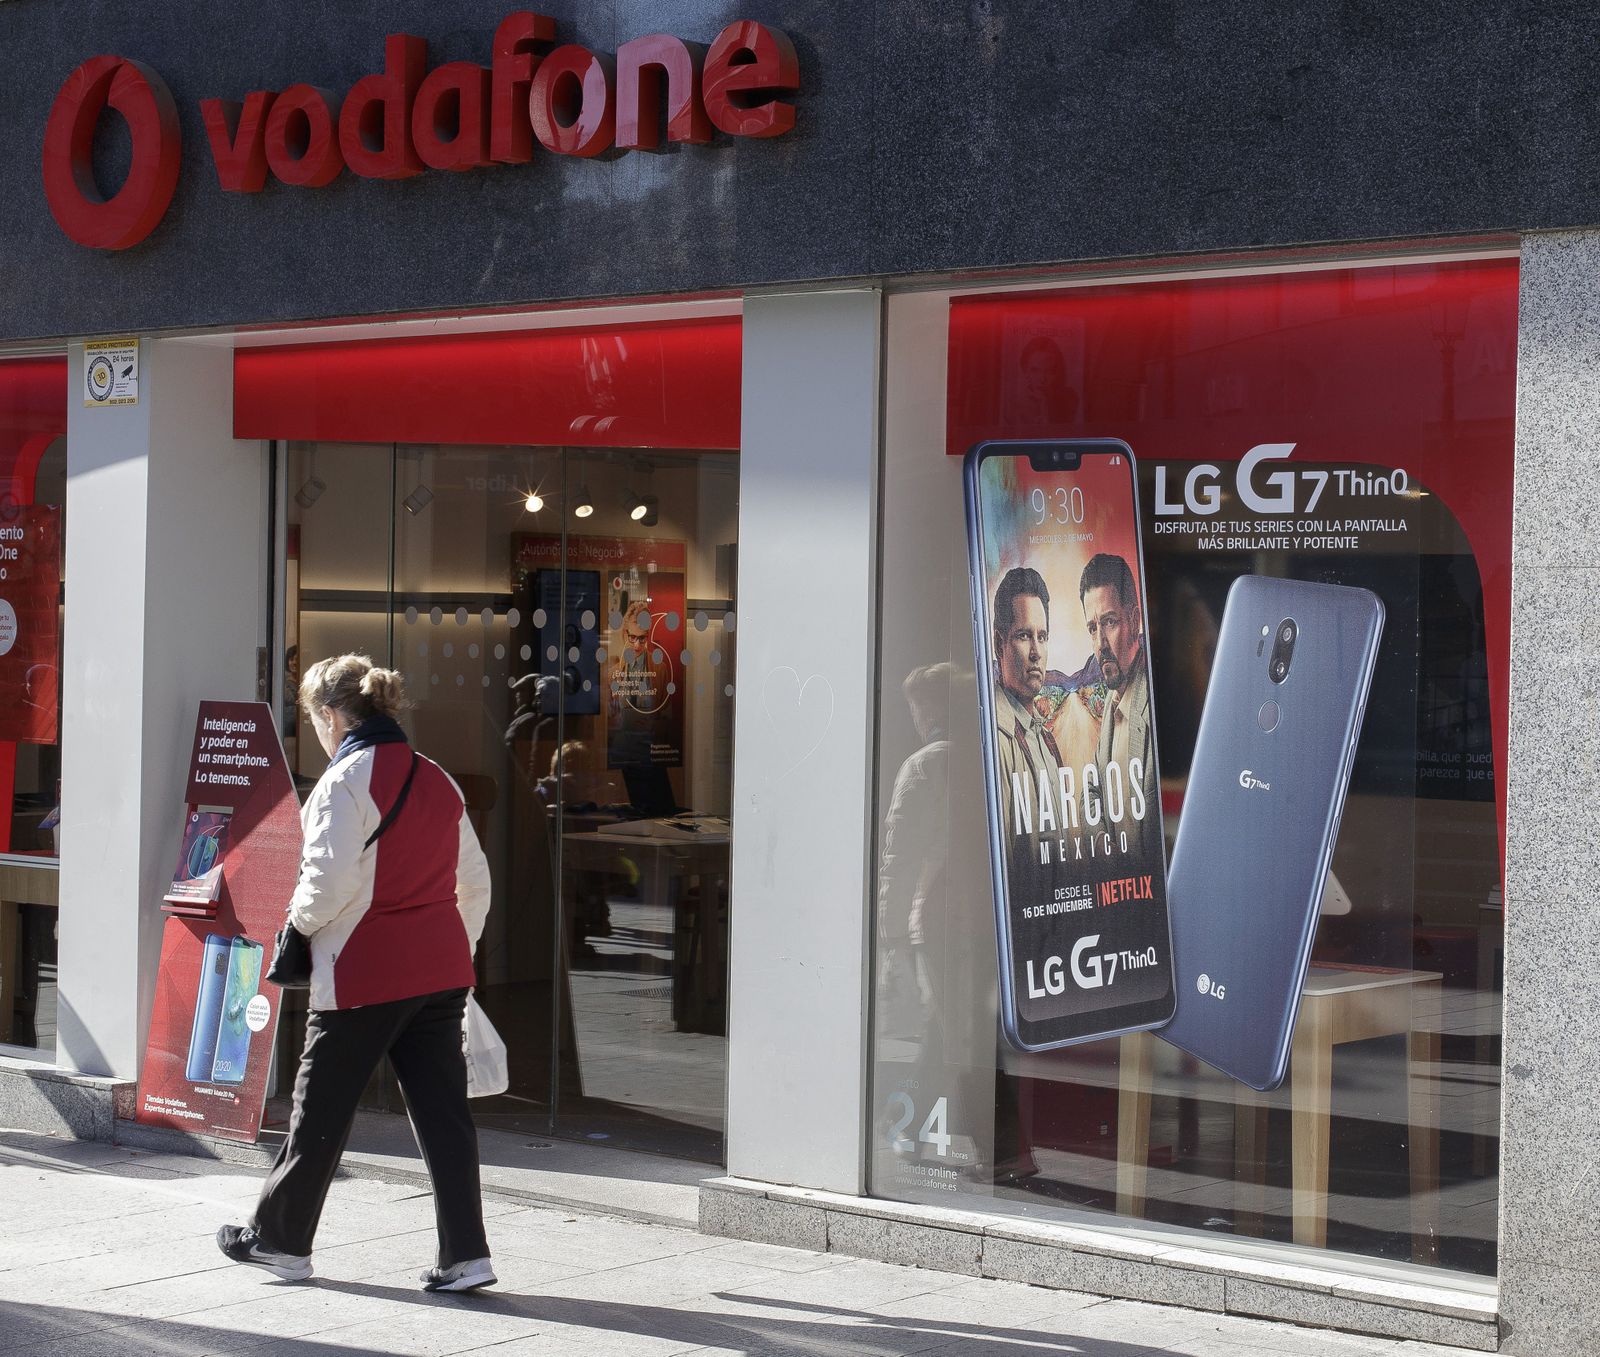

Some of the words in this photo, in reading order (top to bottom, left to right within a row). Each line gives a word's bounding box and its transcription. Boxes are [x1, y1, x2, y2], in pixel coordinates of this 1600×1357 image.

[201, 11, 798, 193] vodafone
[87, 342, 107, 350] RECINTO
[1155, 464, 1221, 515] LG
[1333, 468, 1410, 497] ThinQ
[1031, 486, 1085, 526] 9:30
[0, 525, 24, 540] ento
[1154, 520, 1209, 534] DISFRUTA
[1211, 520, 1227, 534] DE
[1228, 520, 1251, 533] TUS
[1254, 520, 1294, 533] SERIES
[1296, 520, 1323, 533] CON
[1326, 519, 1342, 532] LA
[1344, 518, 1408, 532] PANTALLA
[1198, 535, 1224, 550] MÁS
[1226, 536, 1290, 550] BRILLANTE
[1292, 536, 1301, 549] Y
[1303, 536, 1359, 549] POTENTE
[203, 717, 257, 734] Inteligencia
[200, 736, 208, 749] y
[208, 735, 235, 750] poder
[236, 738, 248, 749] en
[198, 752, 211, 763] un
[211, 753, 270, 768] smartphone.
[195, 769, 207, 783] Lo
[208, 771, 251, 786] tenemos.
[1012, 757, 1146, 835] NARCOS
[1040, 830, 1128, 865] MEXICO
[1054, 885, 1081, 900] DESDE
[1082, 884, 1093, 897] EL
[1101, 875, 1154, 907] NETFLIX
[1022, 906, 1033, 919] 16
[1033, 905, 1045, 917] DE
[1046, 898, 1093, 916] NOVIEMBRE
[1026, 955, 1065, 999] LG
[1119, 946, 1158, 971] ThinQ
[1210, 981, 1226, 1000] LG
[885, 1090, 952, 1157] 24
[951, 1149, 969, 1160] horas
[927, 1164, 958, 1180] online
[895, 1175, 958, 1192] www.vodafone.es
